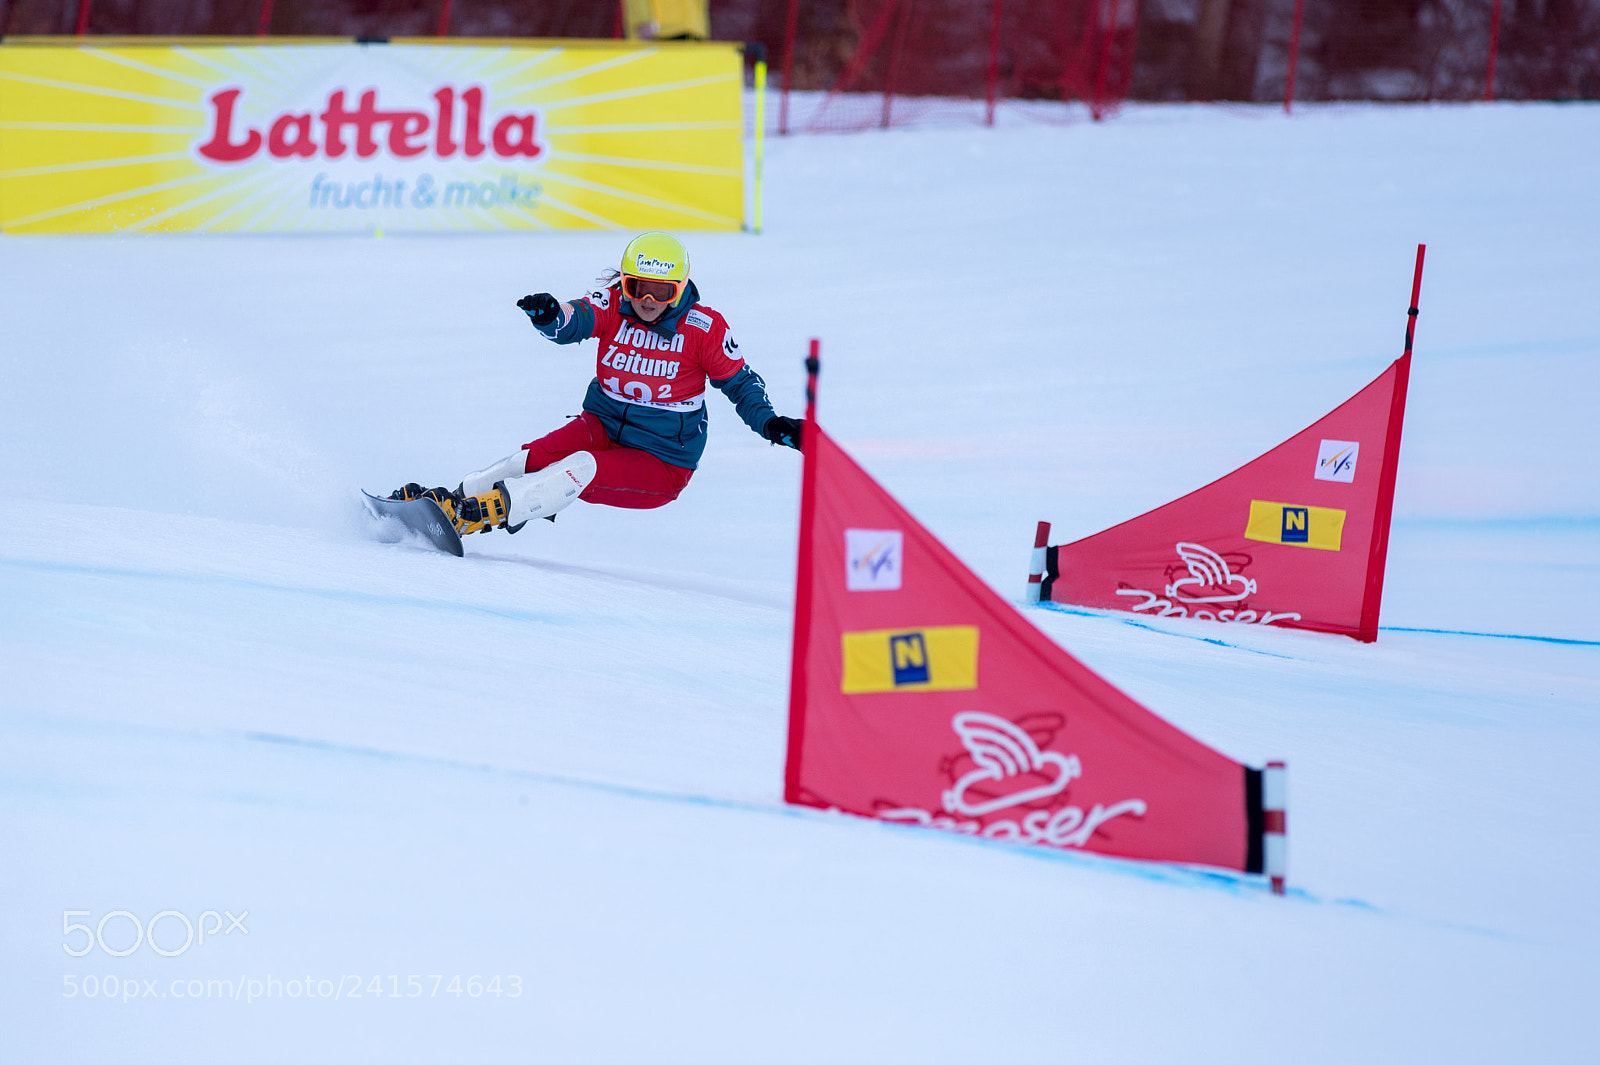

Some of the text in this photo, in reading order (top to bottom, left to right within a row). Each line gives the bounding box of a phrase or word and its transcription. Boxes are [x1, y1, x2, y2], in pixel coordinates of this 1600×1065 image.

[198, 86, 542, 162] Lattella
[309, 174, 543, 210] frucht & molke
[600, 344, 681, 380] Zeitung
[657, 384, 672, 399] 2
[1285, 510, 1306, 532] N
[893, 638, 926, 669] N
